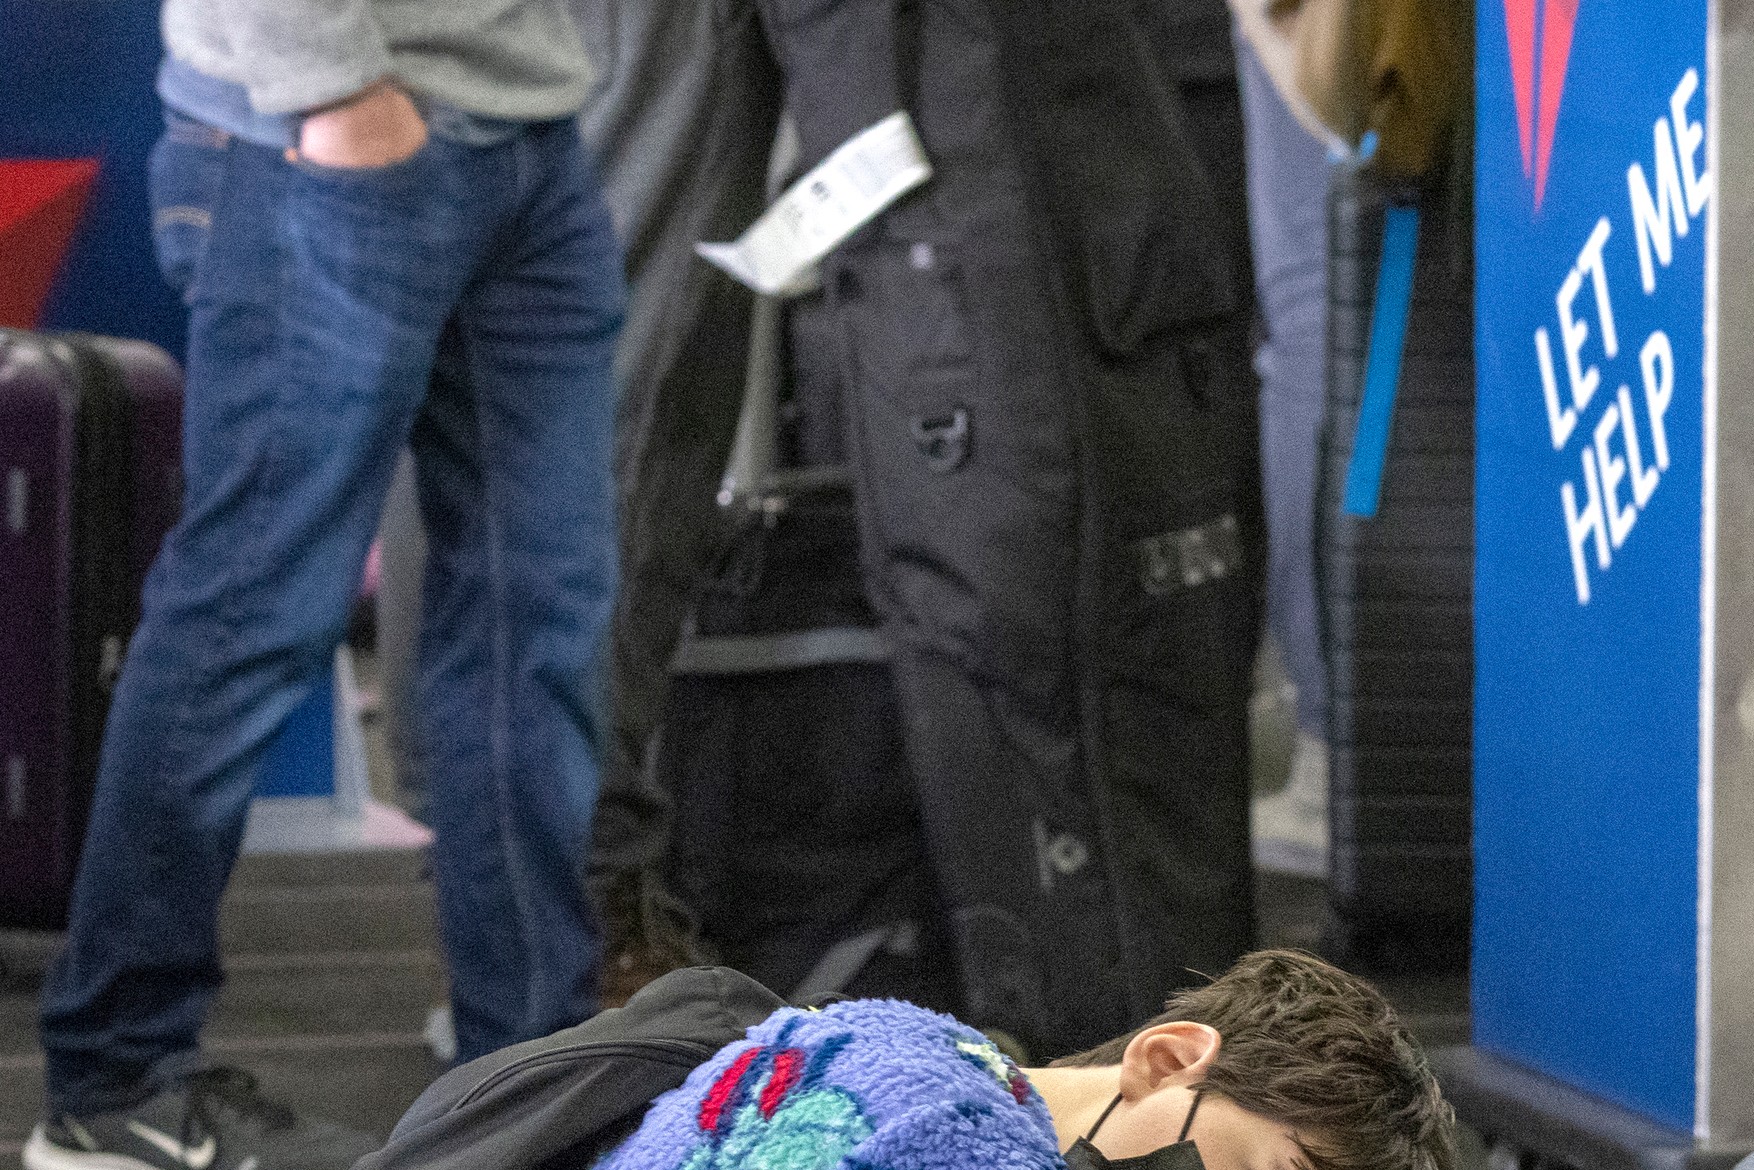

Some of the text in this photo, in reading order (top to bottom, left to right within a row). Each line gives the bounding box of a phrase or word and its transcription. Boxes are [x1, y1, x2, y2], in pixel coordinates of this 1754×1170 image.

[1534, 66, 1711, 451] LET ME
[1560, 329, 1675, 605] HELP
